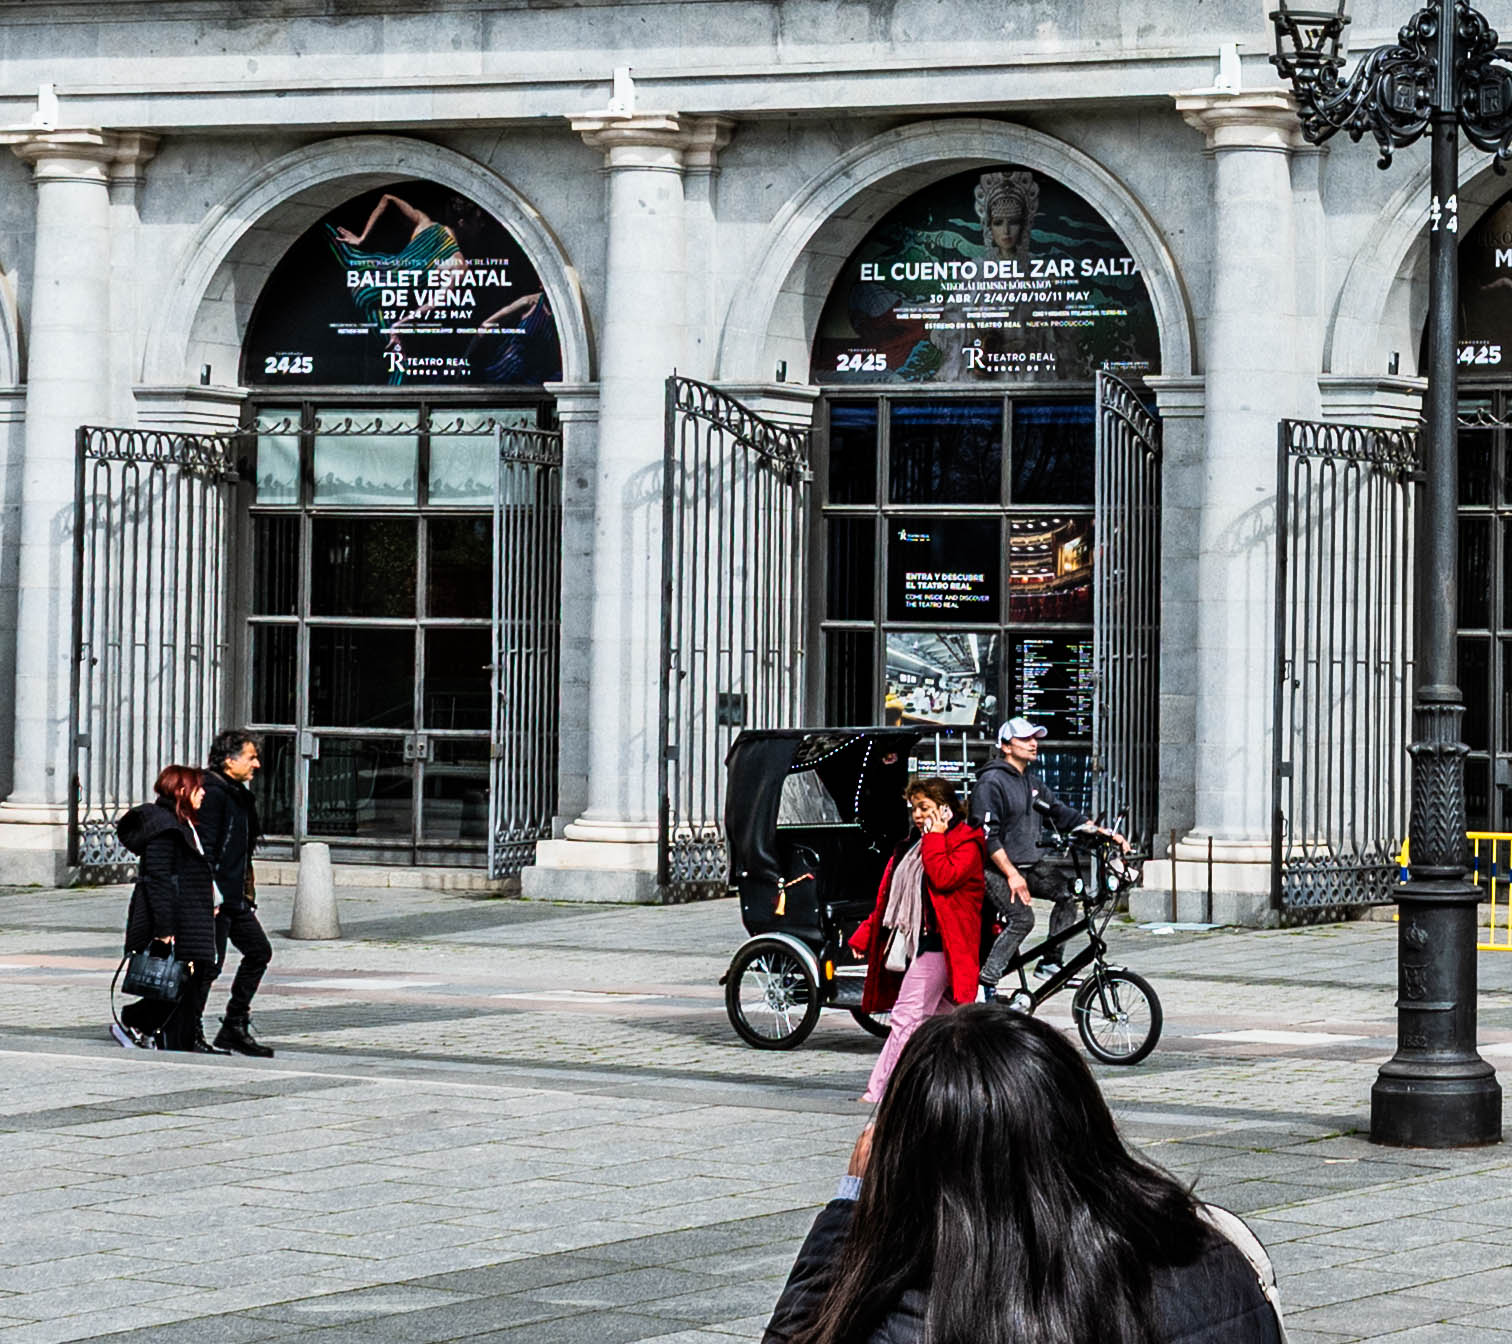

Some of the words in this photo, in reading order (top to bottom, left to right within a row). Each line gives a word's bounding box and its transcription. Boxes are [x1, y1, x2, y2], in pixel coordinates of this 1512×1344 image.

[860, 262, 885, 281] EL
[890, 261, 978, 281] CUENTO
[983, 260, 1025, 279] DEL
[1030, 259, 1075, 278] ZAR
[346, 269, 424, 288] BALLET
[427, 269, 512, 287] ESTATAL
[381, 289, 409, 307] DE
[414, 288, 477, 307] VIENA
[929, 293, 944, 304] 30
[946, 293, 971, 303] ABR
[984, 290, 1062, 303] 2/4/6/8/10/11
[1066, 291, 1090, 301] MAY
[383, 310, 397, 320] 23
[408, 310, 422, 320] 24
[434, 310, 447, 320] 25
[450, 310, 473, 320] MAY
[977, 321, 1003, 329] TEATRO
[383, 351, 405, 372] TR
[407, 357, 444, 366] TEATRO
[446, 357, 471, 366] REAL
[961, 347, 986, 369] TR
[988, 352, 1027, 362] TEATRO
[1029, 352, 1055, 361] REAL
[905, 572, 933, 581] ENTRA
[905, 581, 916, 590] EL
[917, 581, 949, 590] TEATRO
[949, 582, 972, 591] REAL
